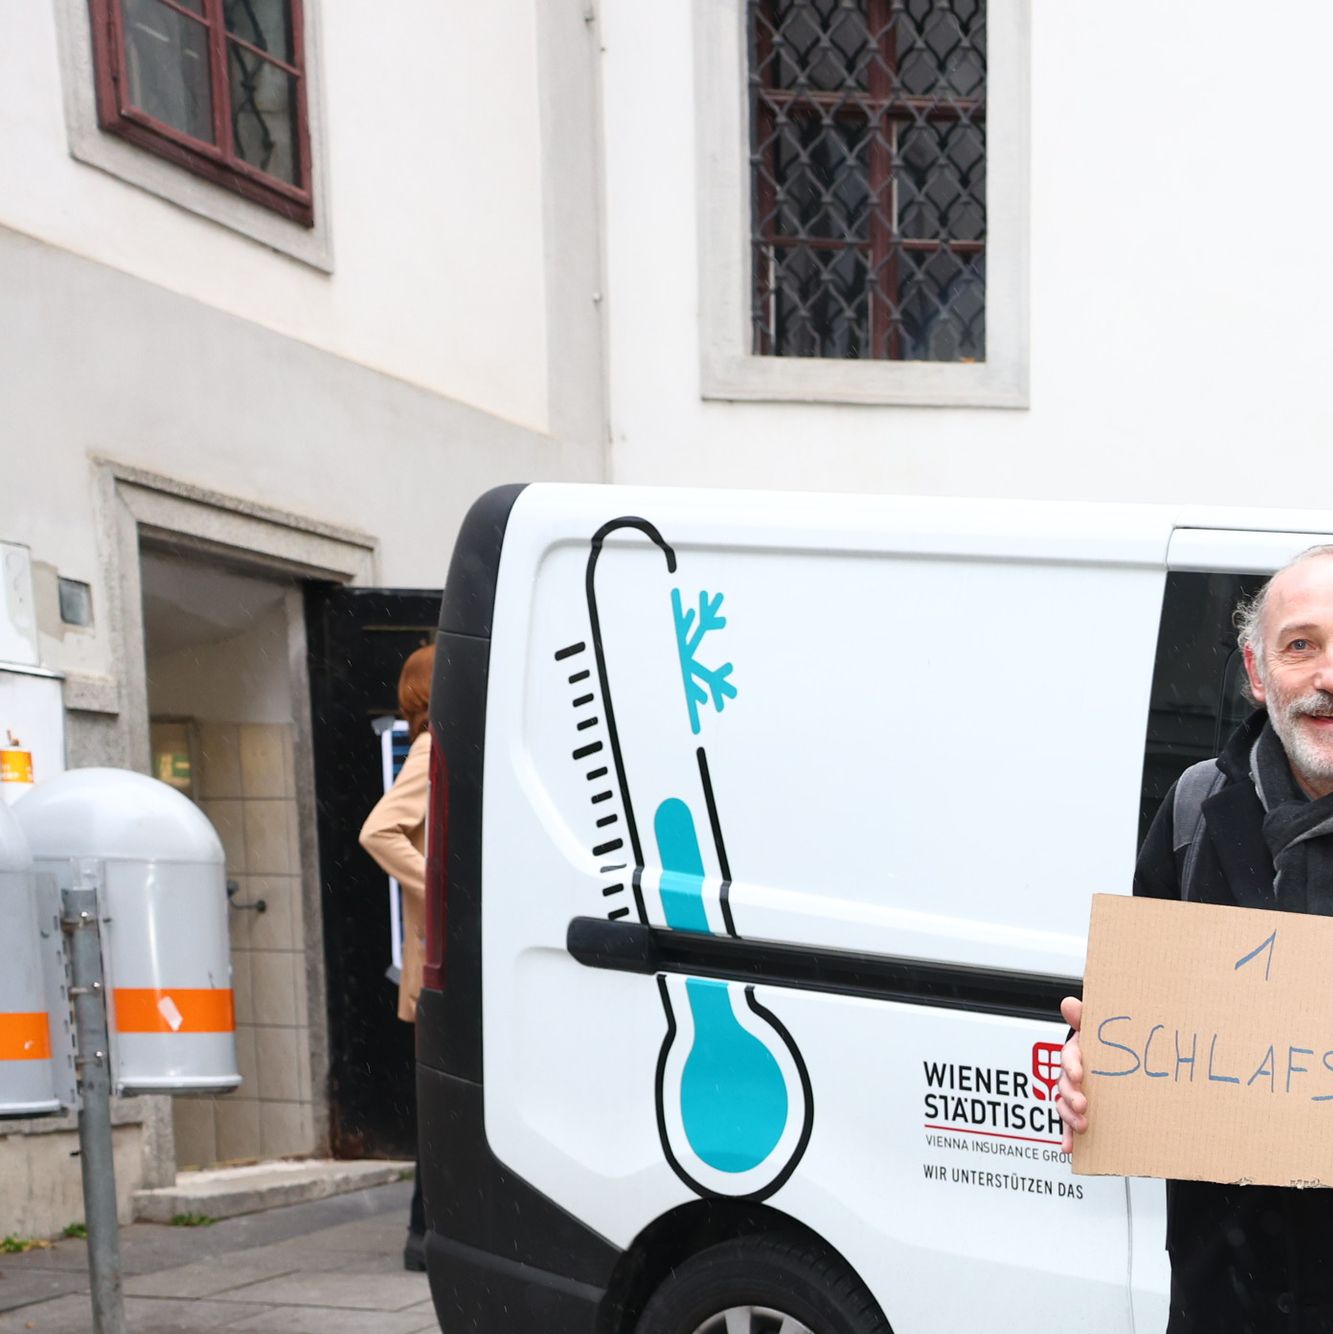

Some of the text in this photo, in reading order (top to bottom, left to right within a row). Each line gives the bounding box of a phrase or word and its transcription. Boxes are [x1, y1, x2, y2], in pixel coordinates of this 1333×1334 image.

[1235, 929, 1277, 981] 1
[923, 1061, 1029, 1098] WIENER
[924, 1093, 1063, 1135] STÄDTISCH
[926, 1135, 1072, 1164] VIENNA INSURANCE GROU
[923, 1164, 1084, 1199] WIR UNTERSTÜTZEN DAS
